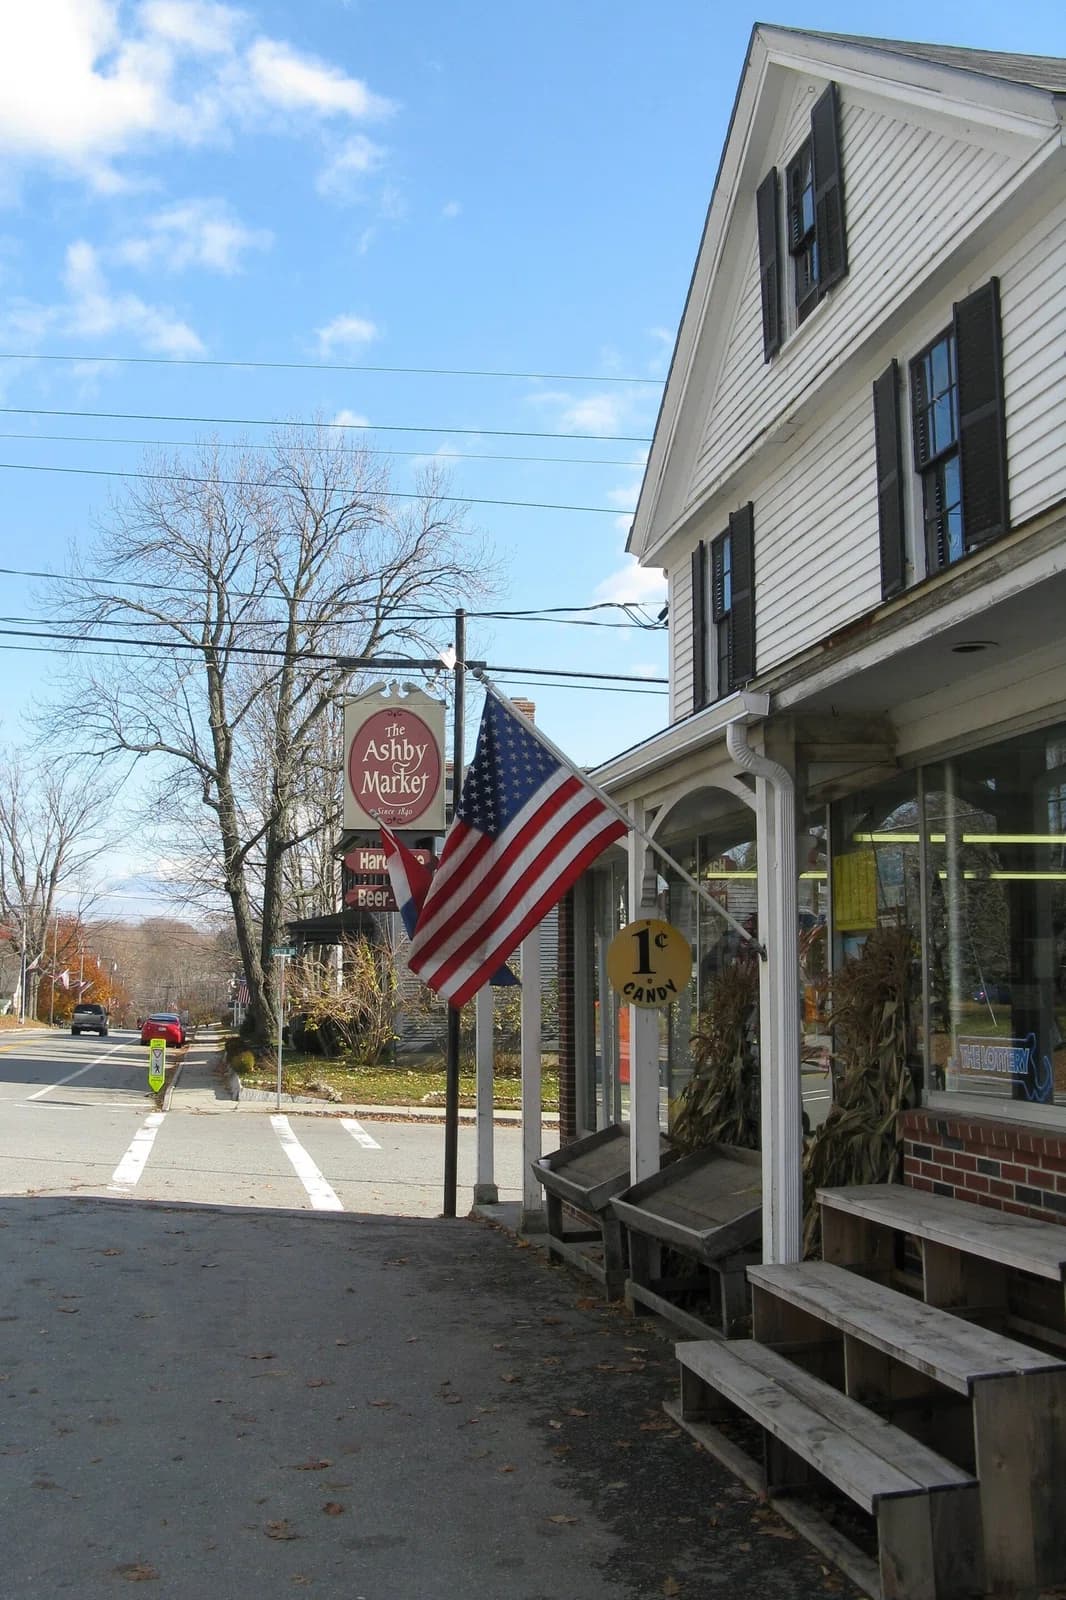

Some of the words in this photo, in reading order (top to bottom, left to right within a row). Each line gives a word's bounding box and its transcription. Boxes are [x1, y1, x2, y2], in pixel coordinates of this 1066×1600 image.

[385, 723, 406, 738] The
[362, 739, 429, 774] Ashby
[361, 768, 430, 807] Market
[377, 807, 394, 815] Since
[623, 978, 678, 1003] CANDY
[959, 1043, 981, 1070] THE
[981, 1045, 1030, 1075] LOTTERY
